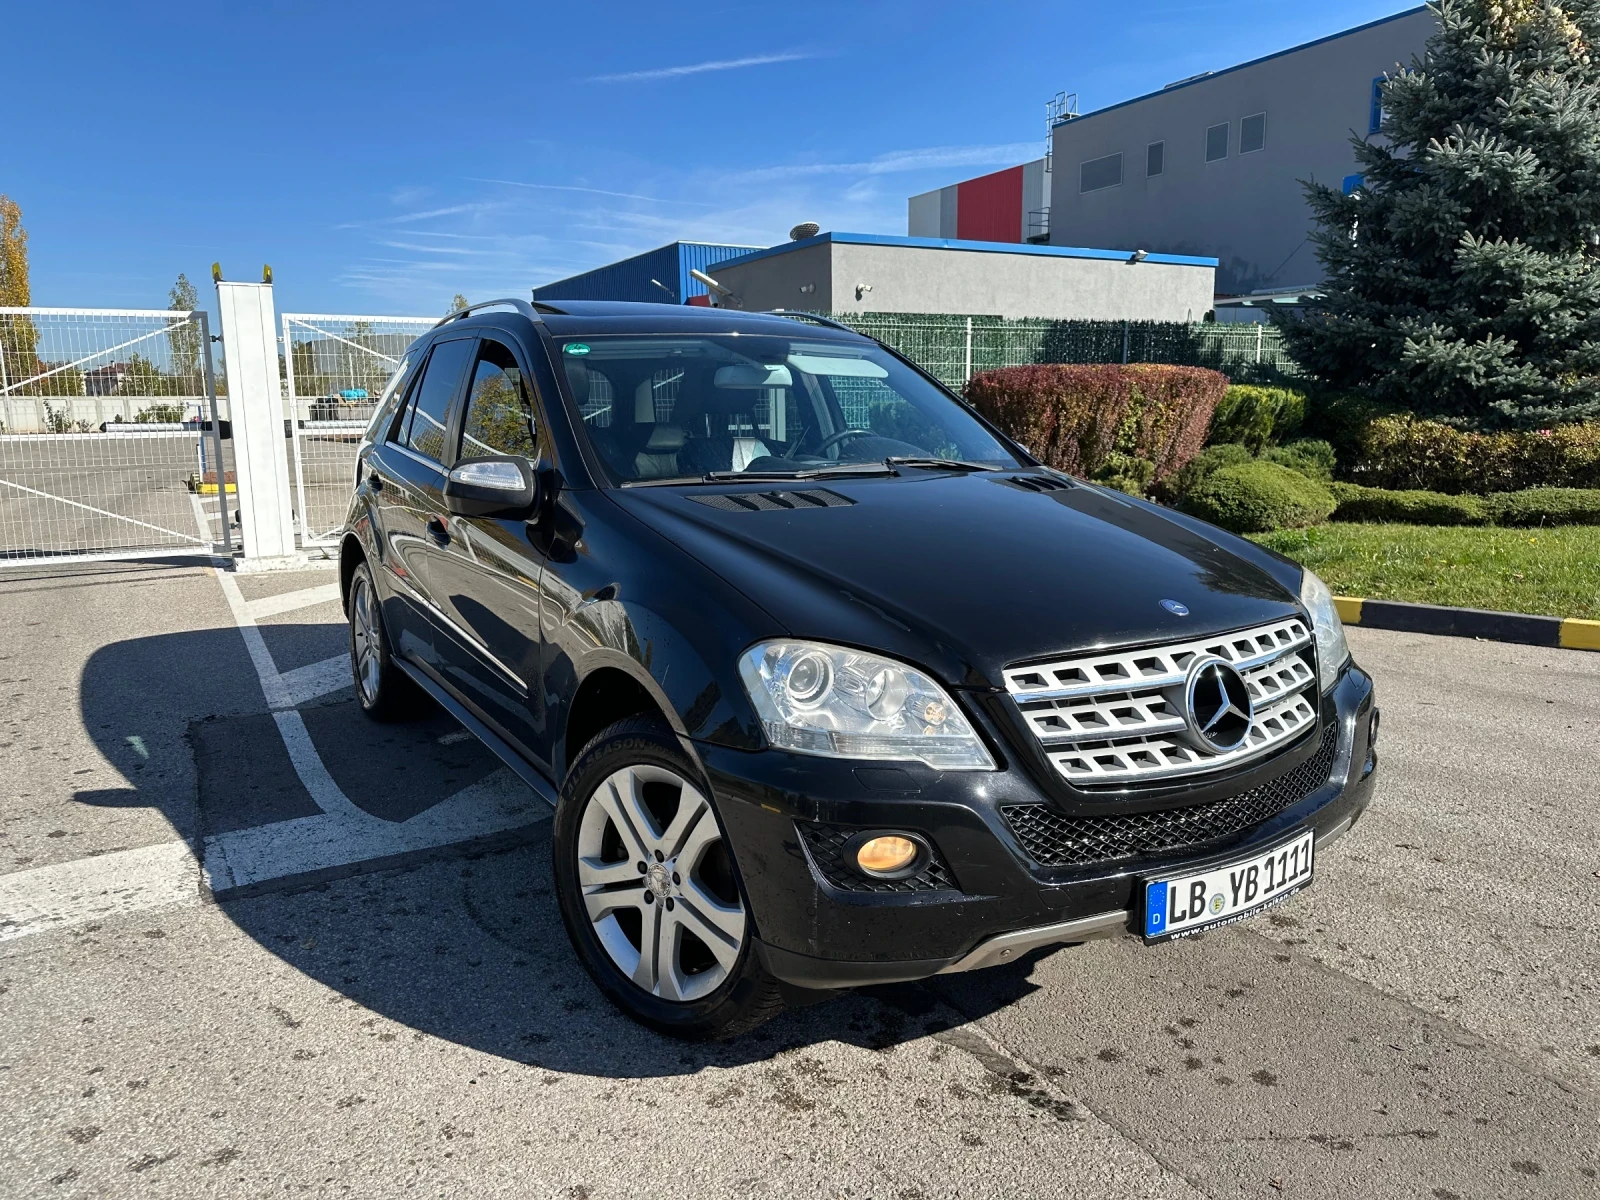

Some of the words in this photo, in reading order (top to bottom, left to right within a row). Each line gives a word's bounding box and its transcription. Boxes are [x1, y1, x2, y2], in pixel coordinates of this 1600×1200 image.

[586, 737, 646, 768] SEASON
[1169, 880, 1206, 924] LB
[1230, 865, 1258, 907] YB
[1264, 839, 1310, 895] 1111
[1152, 913, 1161, 925] D
[1170, 887, 1300, 940] www.automobile-kalkan.de
